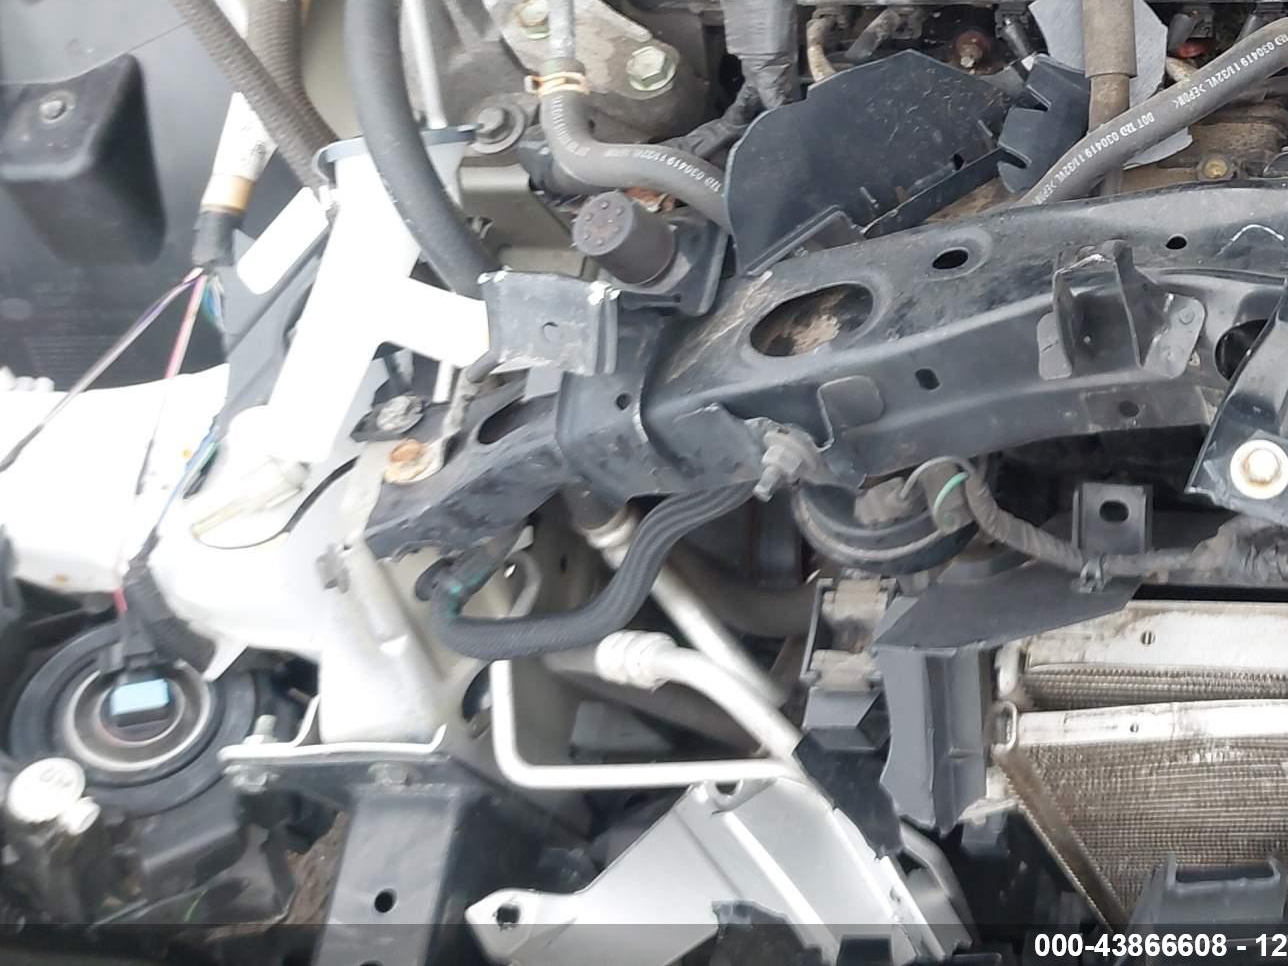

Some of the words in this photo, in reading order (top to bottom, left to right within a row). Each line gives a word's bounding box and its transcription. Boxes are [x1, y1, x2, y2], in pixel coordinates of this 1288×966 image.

[1240, 41, 1275, 67] 030419
[1136, 112, 1156, 129] DOT
[1084, 131, 1120, 158] 030419
